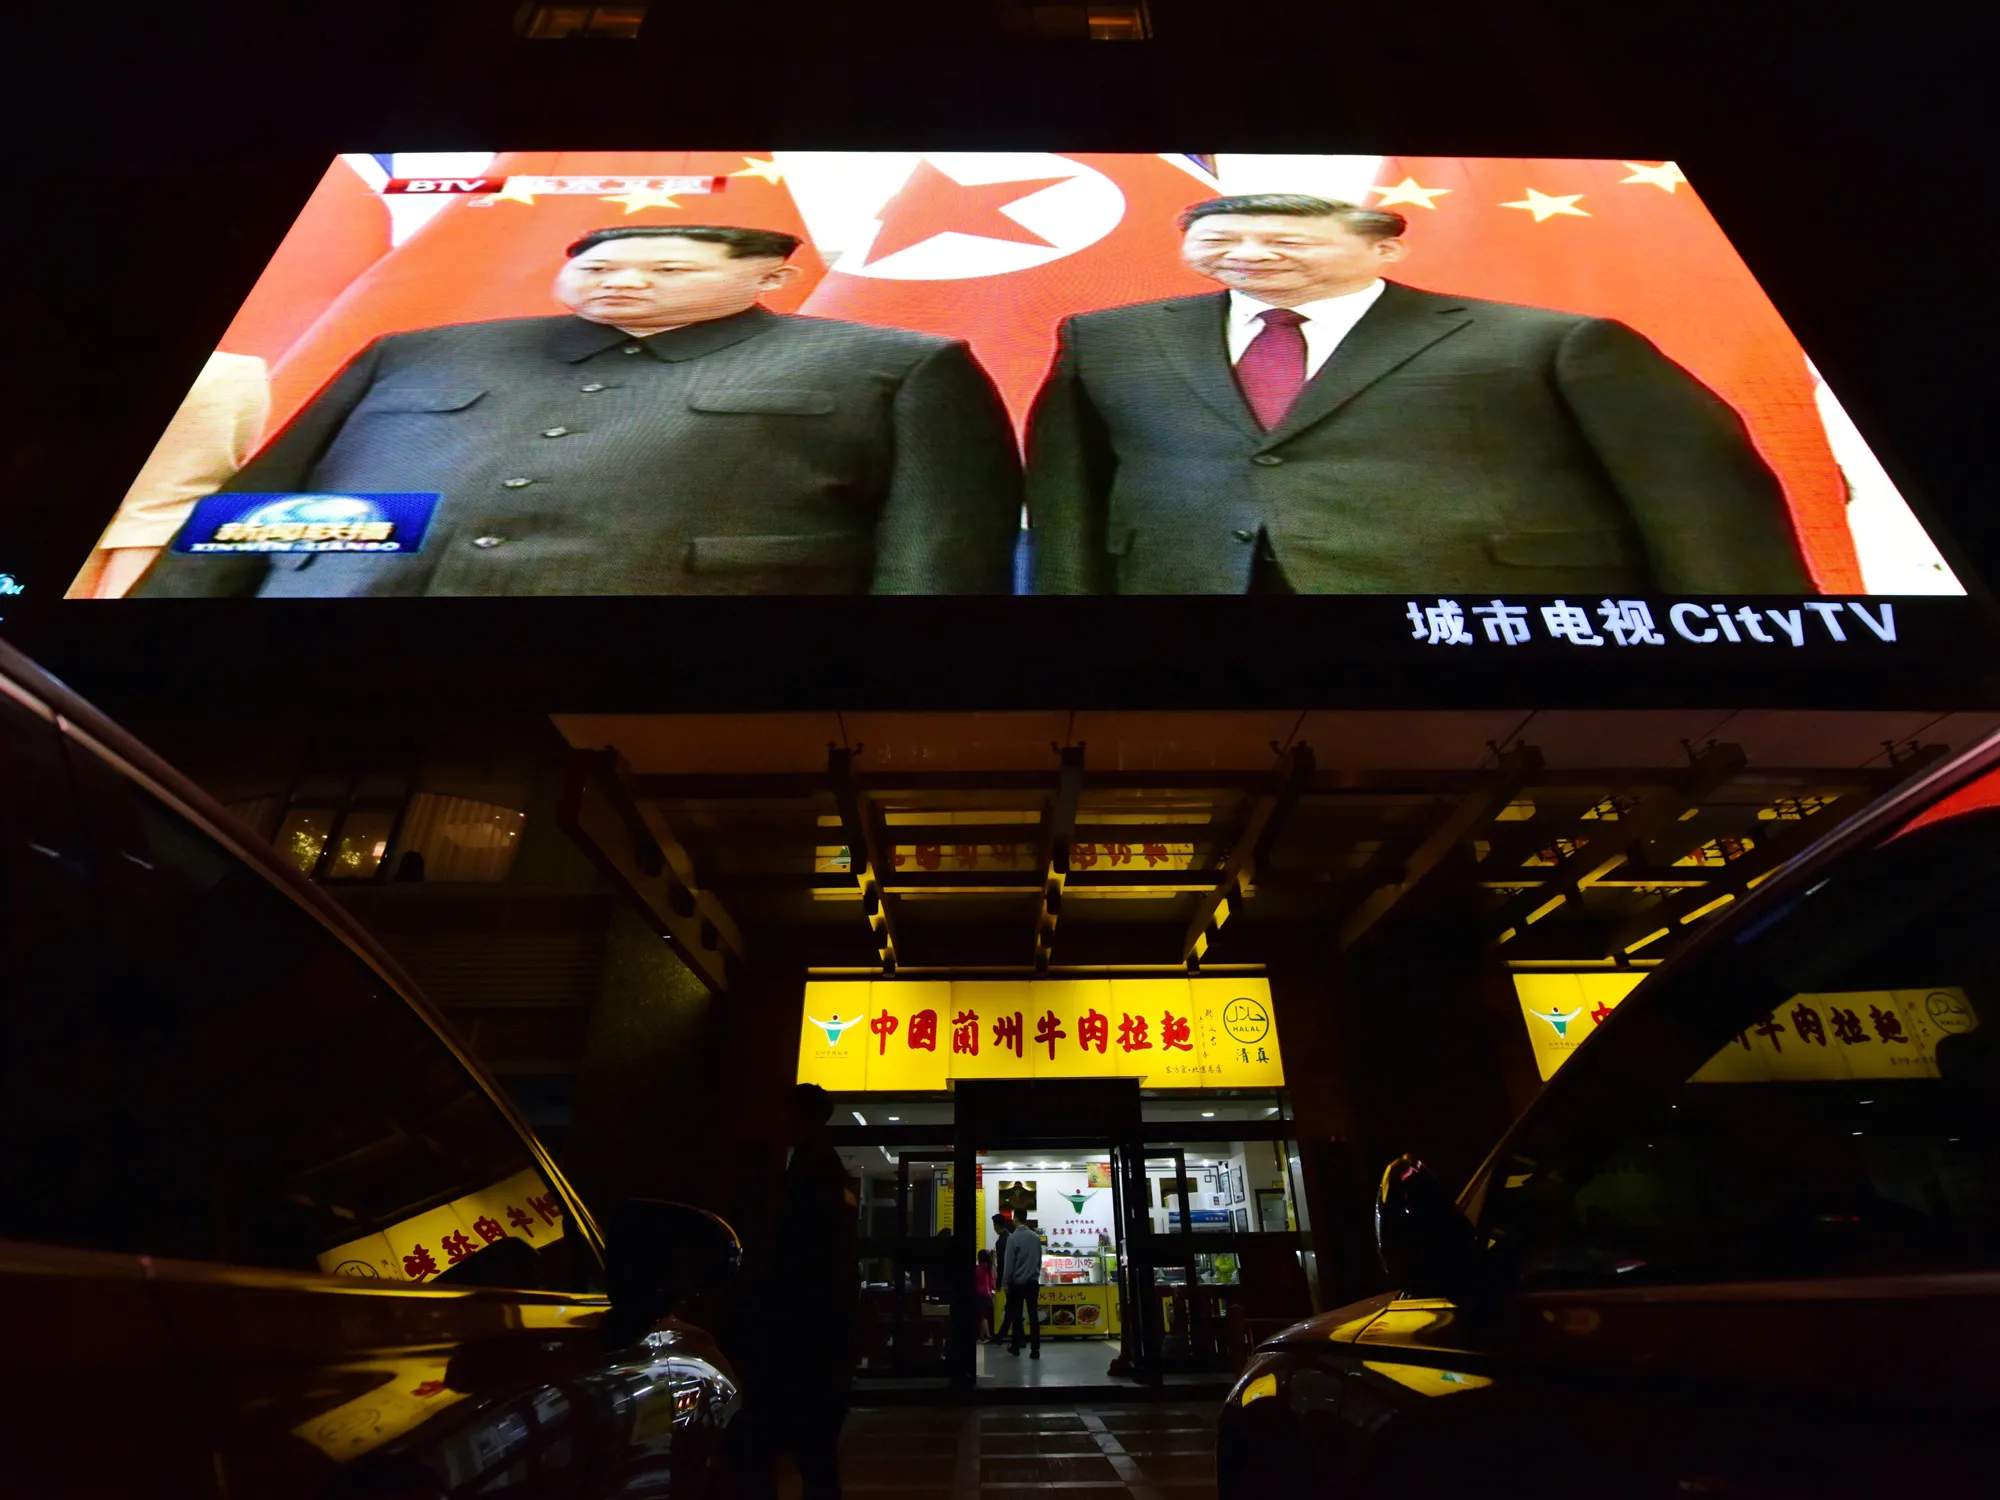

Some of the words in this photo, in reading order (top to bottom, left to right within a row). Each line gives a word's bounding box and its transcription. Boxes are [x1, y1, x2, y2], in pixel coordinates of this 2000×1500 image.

[405, 179, 487, 192] BTV
[1406, 599, 1664, 646] 城市电视
[1670, 602, 1898, 647] CityTV
[1226, 1006, 1266, 1023] حلال
[1236, 1047, 1270, 1064] 清真
